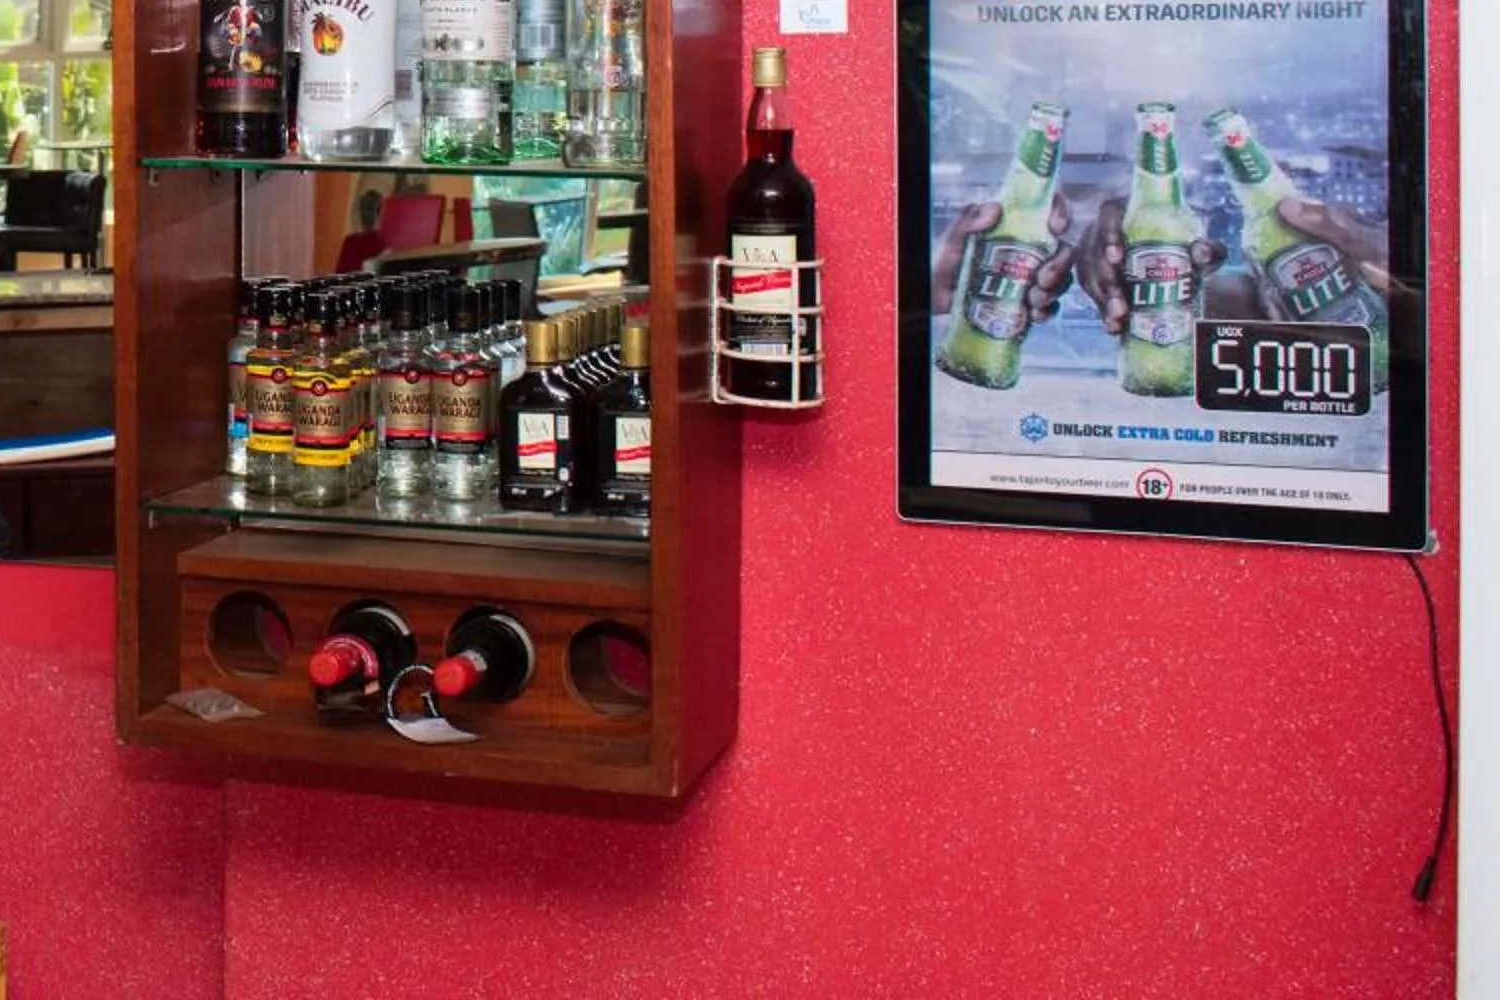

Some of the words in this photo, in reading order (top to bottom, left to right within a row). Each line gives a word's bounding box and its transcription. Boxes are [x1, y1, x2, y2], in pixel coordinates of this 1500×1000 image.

[978, 4, 1062, 24] UNLOCK
[1069, 5, 1098, 23] AN
[1105, 1, 1291, 23] EXTRAORDINARY
[1297, 1, 1367, 20] NIGHT
[1133, 278, 1192, 305] LITE
[1291, 263, 1351, 317] LITE
[1216, 326, 1243, 337] UGX
[1211, 339, 1357, 399] 5,000
[1283, 400, 1307, 411] PER
[1310, 401, 1357, 414] BOTTLE
[1053, 422, 1113, 438] UNLOCK
[1117, 425, 1170, 441] EXTRA
[1174, 427, 1214, 442] COLD
[1218, 429, 1339, 449] REFRESHMENT
[1141, 478, 1168, 496] 18+
[1179, 483, 1197, 493] FOR
[1199, 485, 1233, 495] PEOPLE
[1261, 488, 1277, 497] THE
